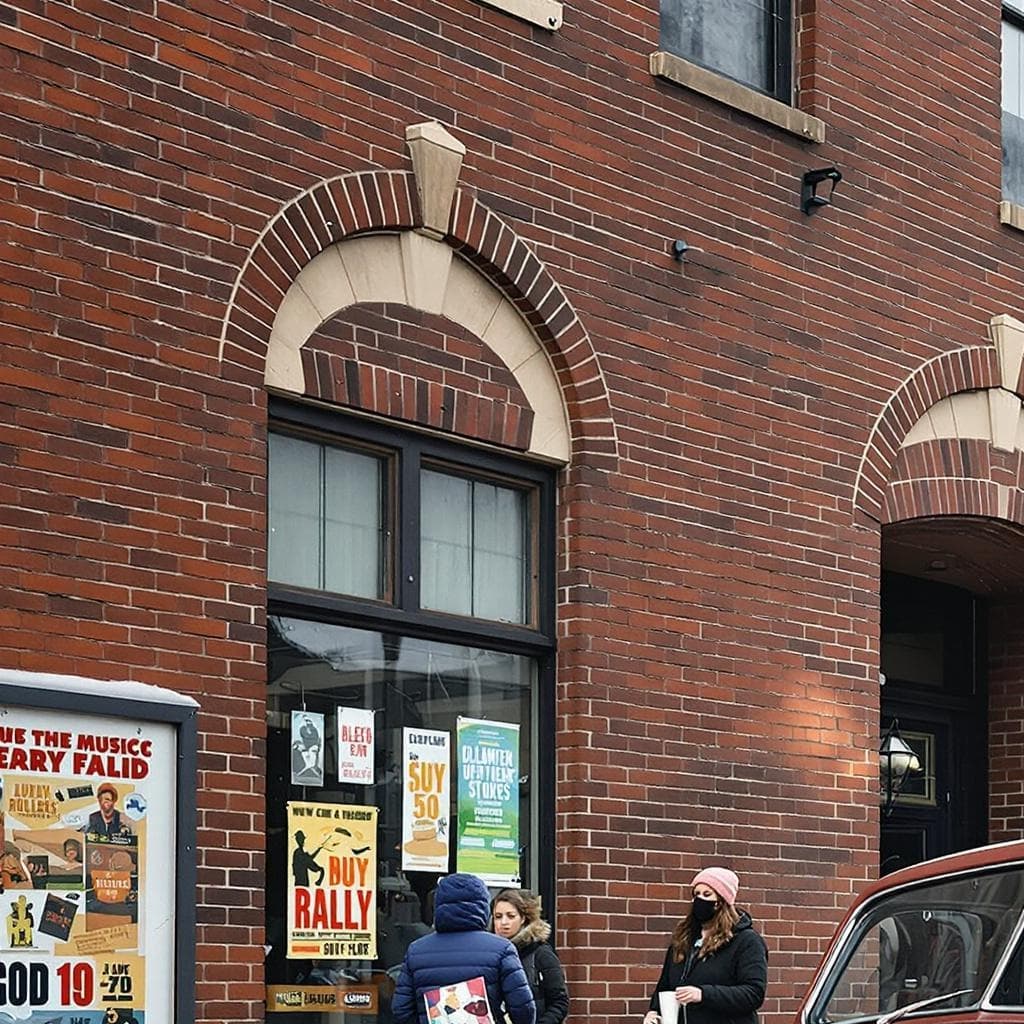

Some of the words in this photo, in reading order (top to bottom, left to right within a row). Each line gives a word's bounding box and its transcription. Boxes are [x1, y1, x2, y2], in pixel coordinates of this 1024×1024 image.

[31, 729, 72, 749] THE
[73, 752, 149, 779] FALID
[408, 761, 446, 793] SUY
[412, 793, 440, 820] 50
[329, 855, 369, 887] BUY
[294, 887, 372, 930] RALLY
[56, 962, 94, 1007] 19
